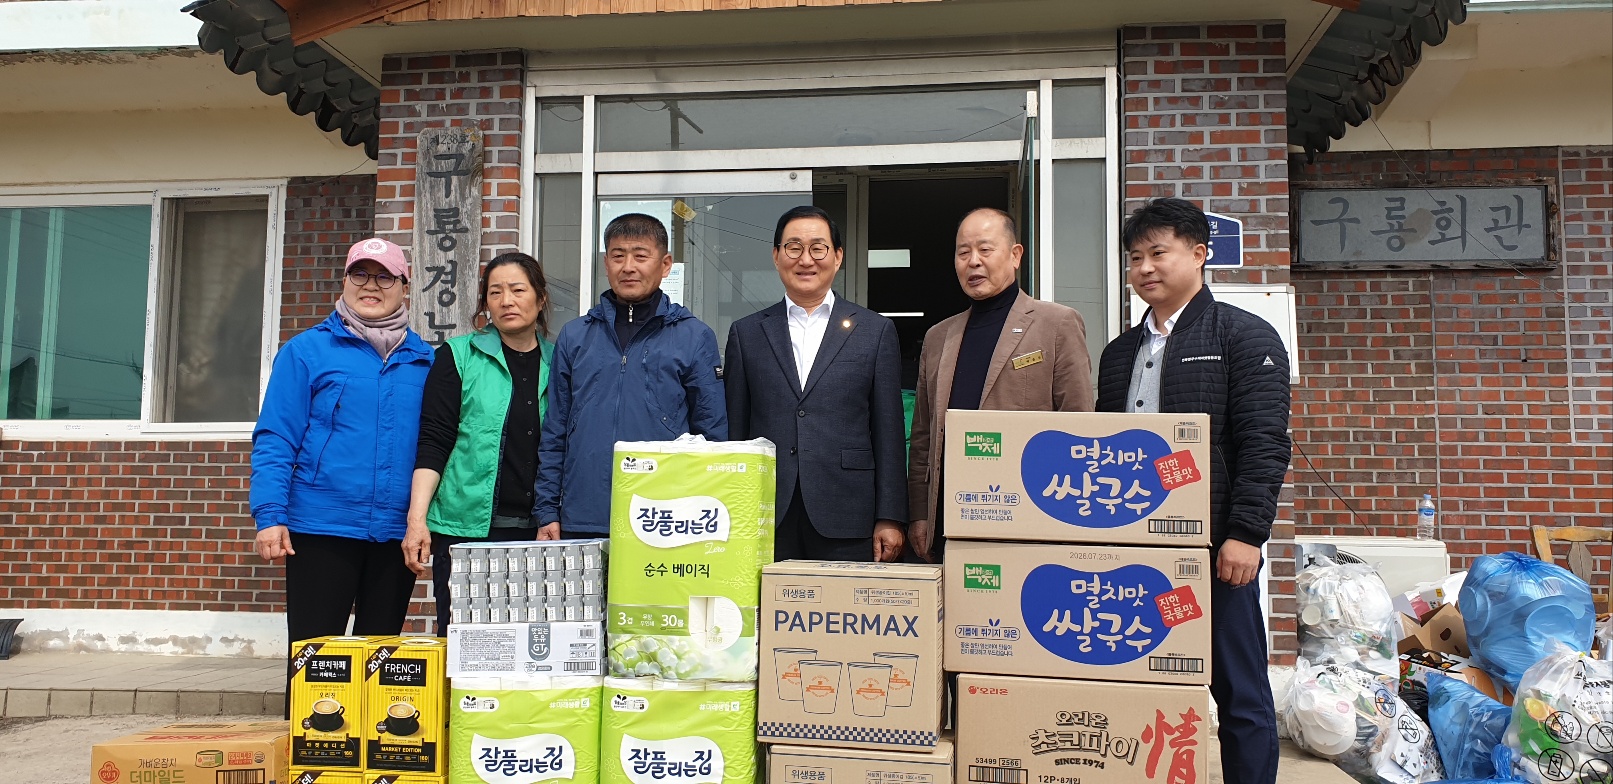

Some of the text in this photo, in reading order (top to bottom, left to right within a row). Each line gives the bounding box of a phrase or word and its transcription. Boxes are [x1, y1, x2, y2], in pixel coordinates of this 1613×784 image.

[1310, 194, 1532, 255] 구룡회관
[966, 434, 1000, 454] 백제
[1070, 439, 1147, 473] 멸치맛
[1158, 458, 1179, 474] 진한
[1163, 467, 1193, 485] 국물맛
[959, 493, 1018, 504] 기름에 튀기지 않은
[1042, 472, 1151, 516] 쌀국수
[637, 508, 719, 537] 잘풀리는집
[704, 542, 726, 555] Zero
[644, 563, 710, 579] 순수 베이직
[965, 566, 999, 587] 백제
[782, 588, 816, 599] 위생용품
[1070, 573, 1148, 608] 멸치맛
[1159, 594, 1180, 610] 진한
[1164, 603, 1194, 621] 국물맛
[774, 610, 920, 638] PAPERMAX
[1043, 607, 1152, 653] 쌀국수
[533, 635, 546, 643] 두유
[959, 627, 1018, 639] 기름에 튀기지 않은
[532, 643, 546, 651] GT
[310, 660, 347, 670] 프렌치카페
[385, 663, 421, 674] FRENCH
[394, 674, 412, 682] CAFÉ
[979, 687, 1009, 696] 오리온
[1056, 711, 1109, 729] 오리온
[1029, 728, 1139, 765] 초코파이
[1141, 706, 1203, 784] 情
[478, 746, 563, 776] 잘풀리는집
[628, 748, 712, 779] 잘풀리는집
[975, 757, 997, 765] 53499
[1054, 757, 1105, 770] SINCE 1974
[129, 769, 186, 784] 더마일드
[791, 769, 826, 781] 위생용품
